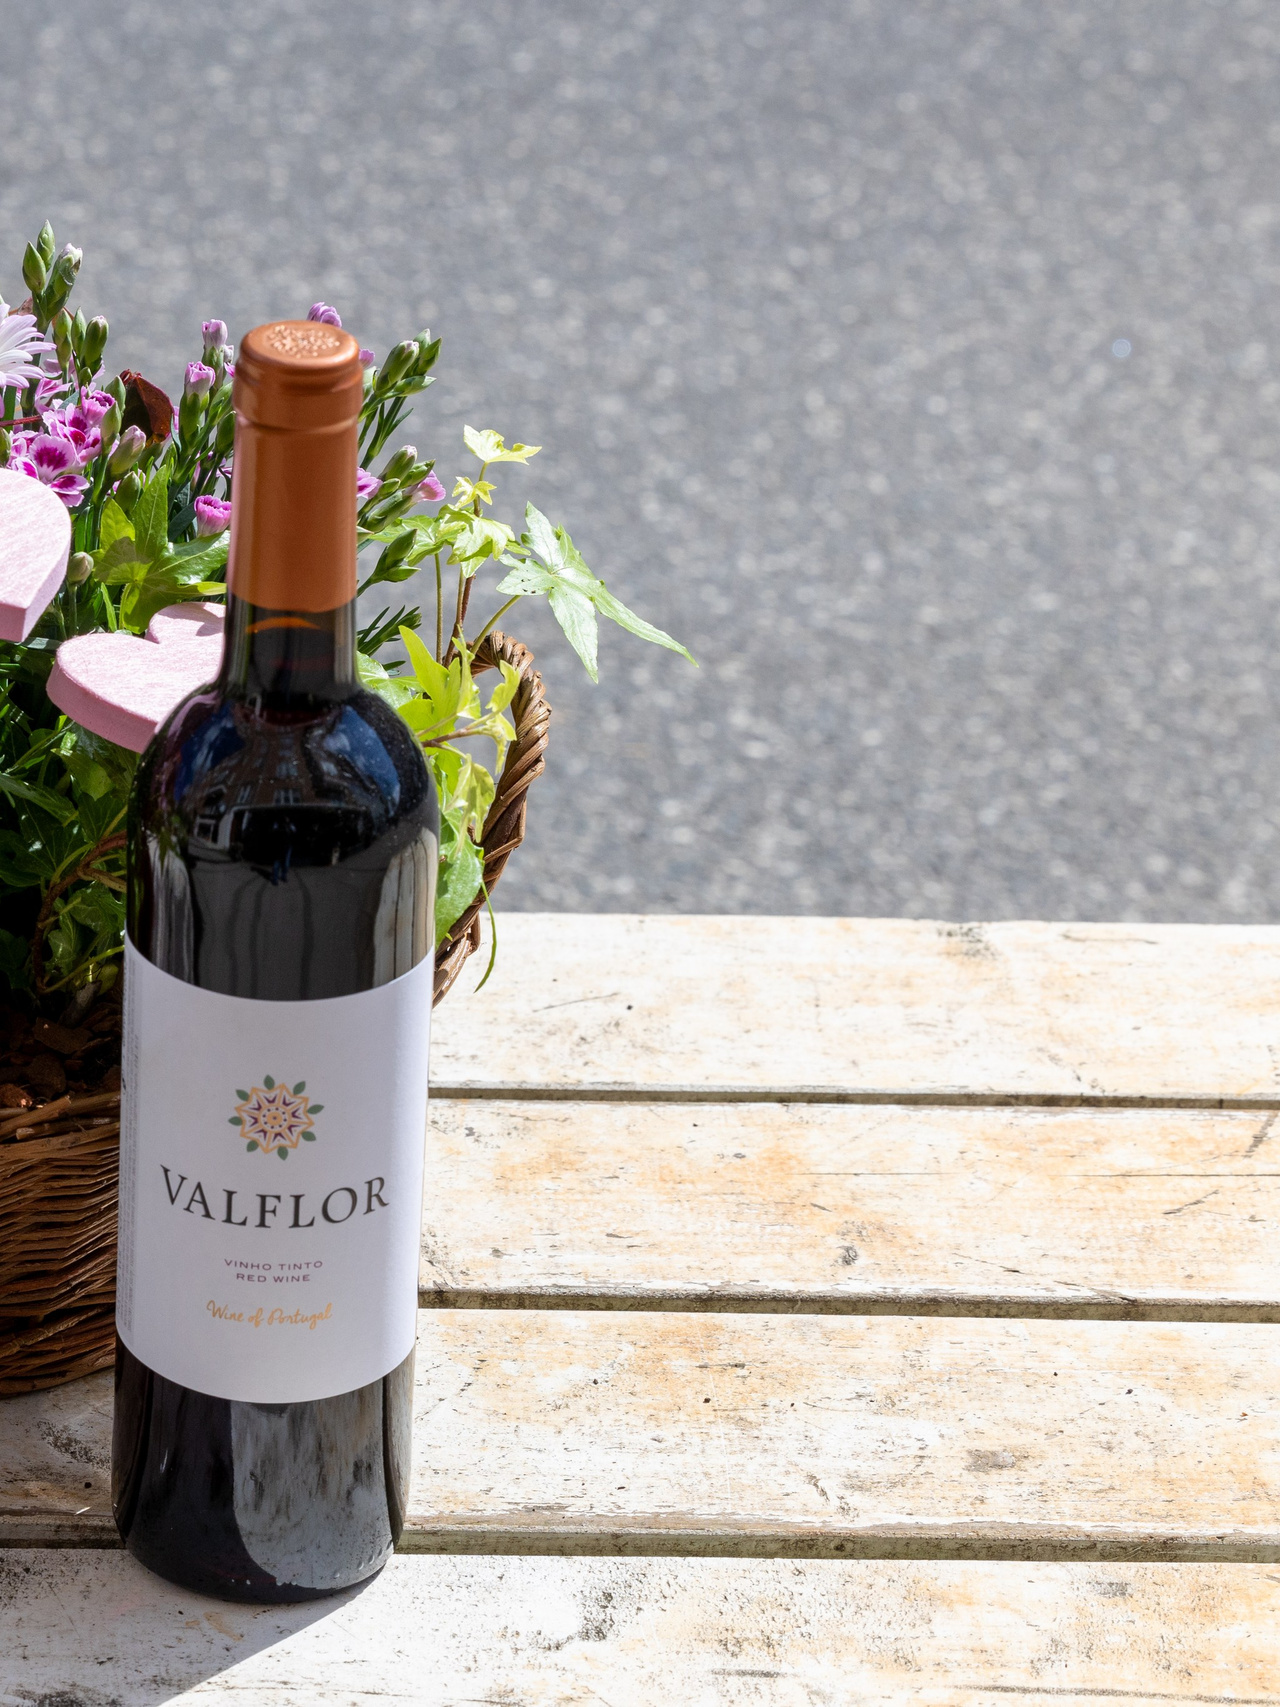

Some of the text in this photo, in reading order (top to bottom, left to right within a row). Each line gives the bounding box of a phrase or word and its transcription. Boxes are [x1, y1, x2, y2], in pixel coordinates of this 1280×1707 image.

[160, 1164, 390, 1229] VALFLOR
[224, 1258, 324, 1271] VINHO TINTO
[236, 1273, 311, 1283] RED WINE
[206, 1300, 333, 1330] Wine of Portugal
